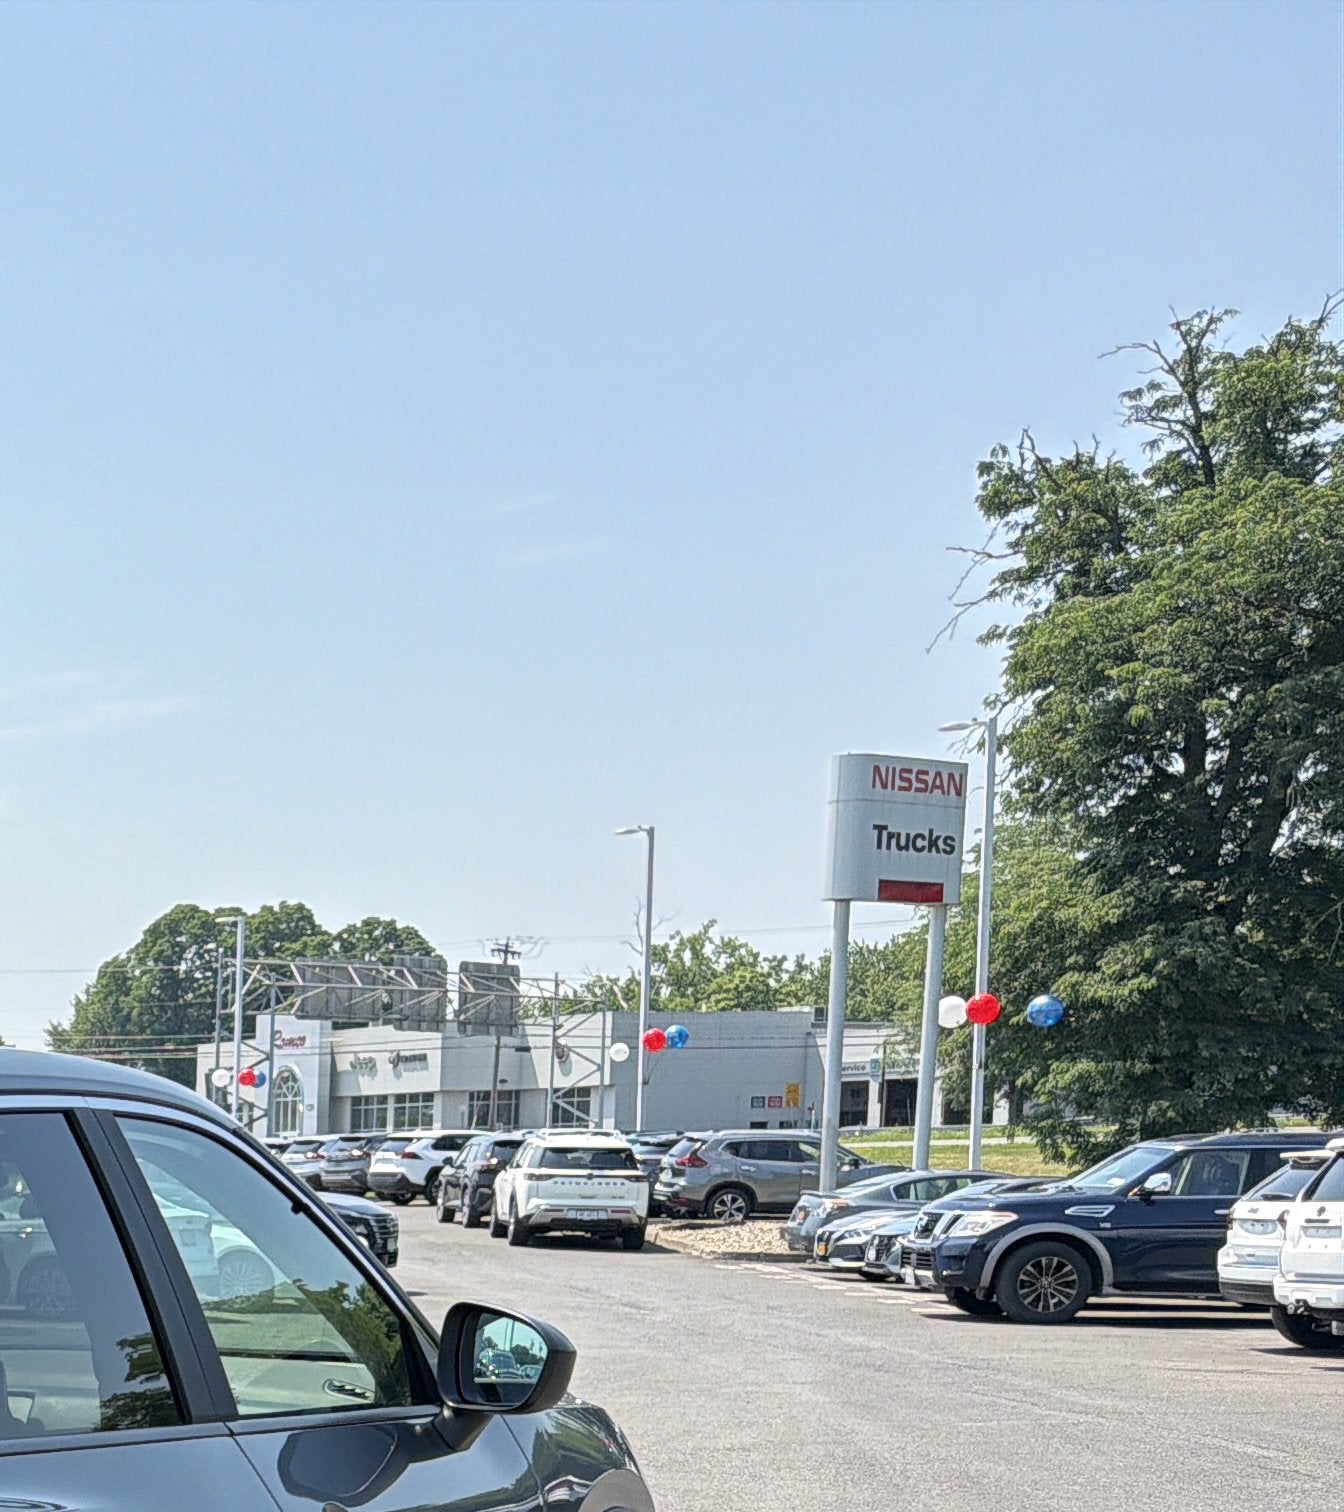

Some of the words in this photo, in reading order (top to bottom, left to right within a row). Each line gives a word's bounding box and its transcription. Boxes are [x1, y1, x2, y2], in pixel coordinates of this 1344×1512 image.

[871, 764, 963, 797] NISSAN
[872, 823, 956, 856] Trucks
[841, 1064, 867, 1074] ervice
